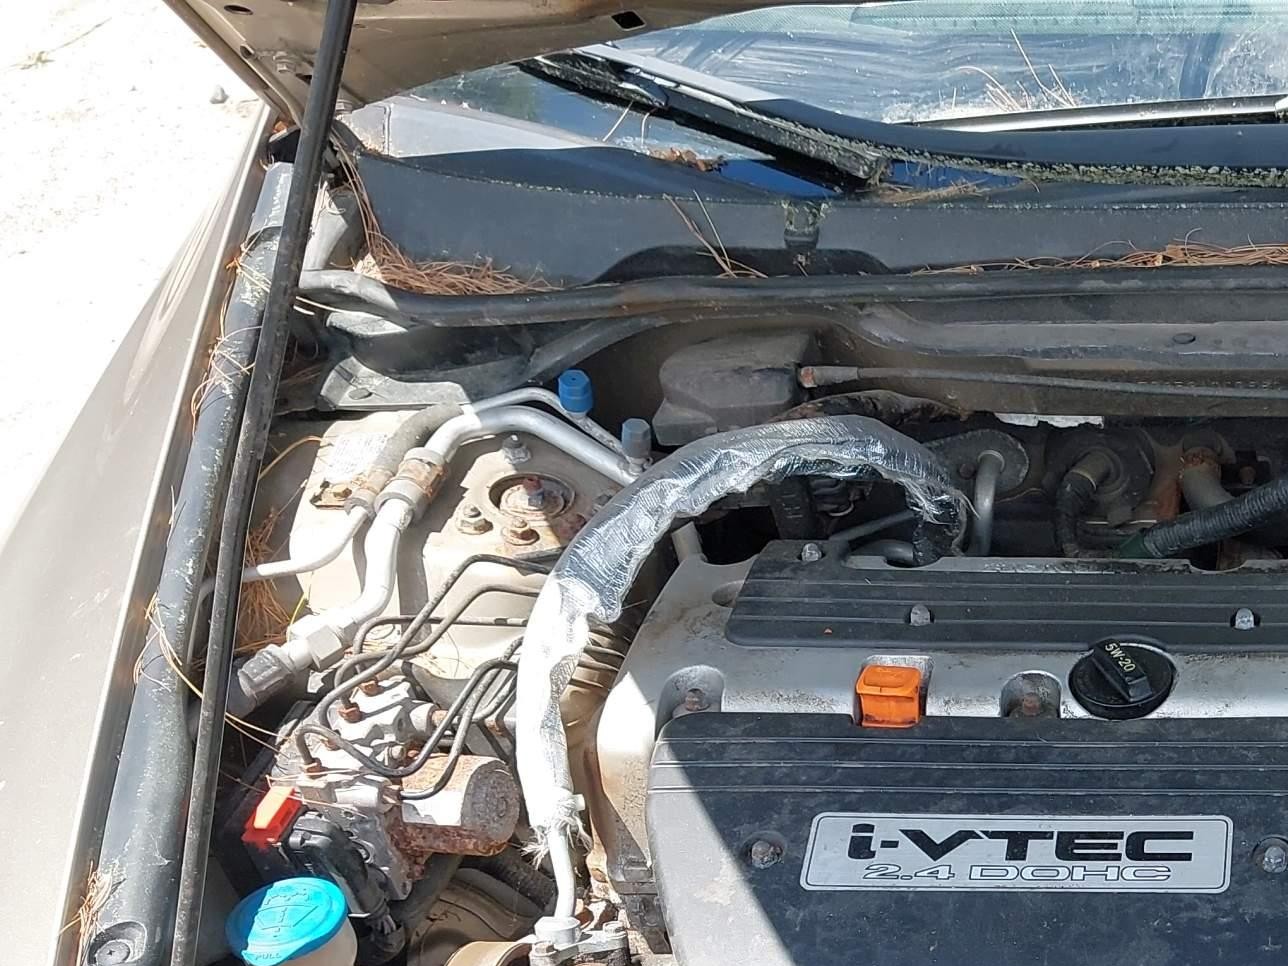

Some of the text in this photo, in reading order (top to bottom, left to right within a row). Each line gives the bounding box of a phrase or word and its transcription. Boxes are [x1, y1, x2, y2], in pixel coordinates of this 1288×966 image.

[1105, 642, 1136, 673] 5W-20
[847, 823, 1195, 862] i-VTEC
[862, 863, 1172, 882] 2.4 DOHC
